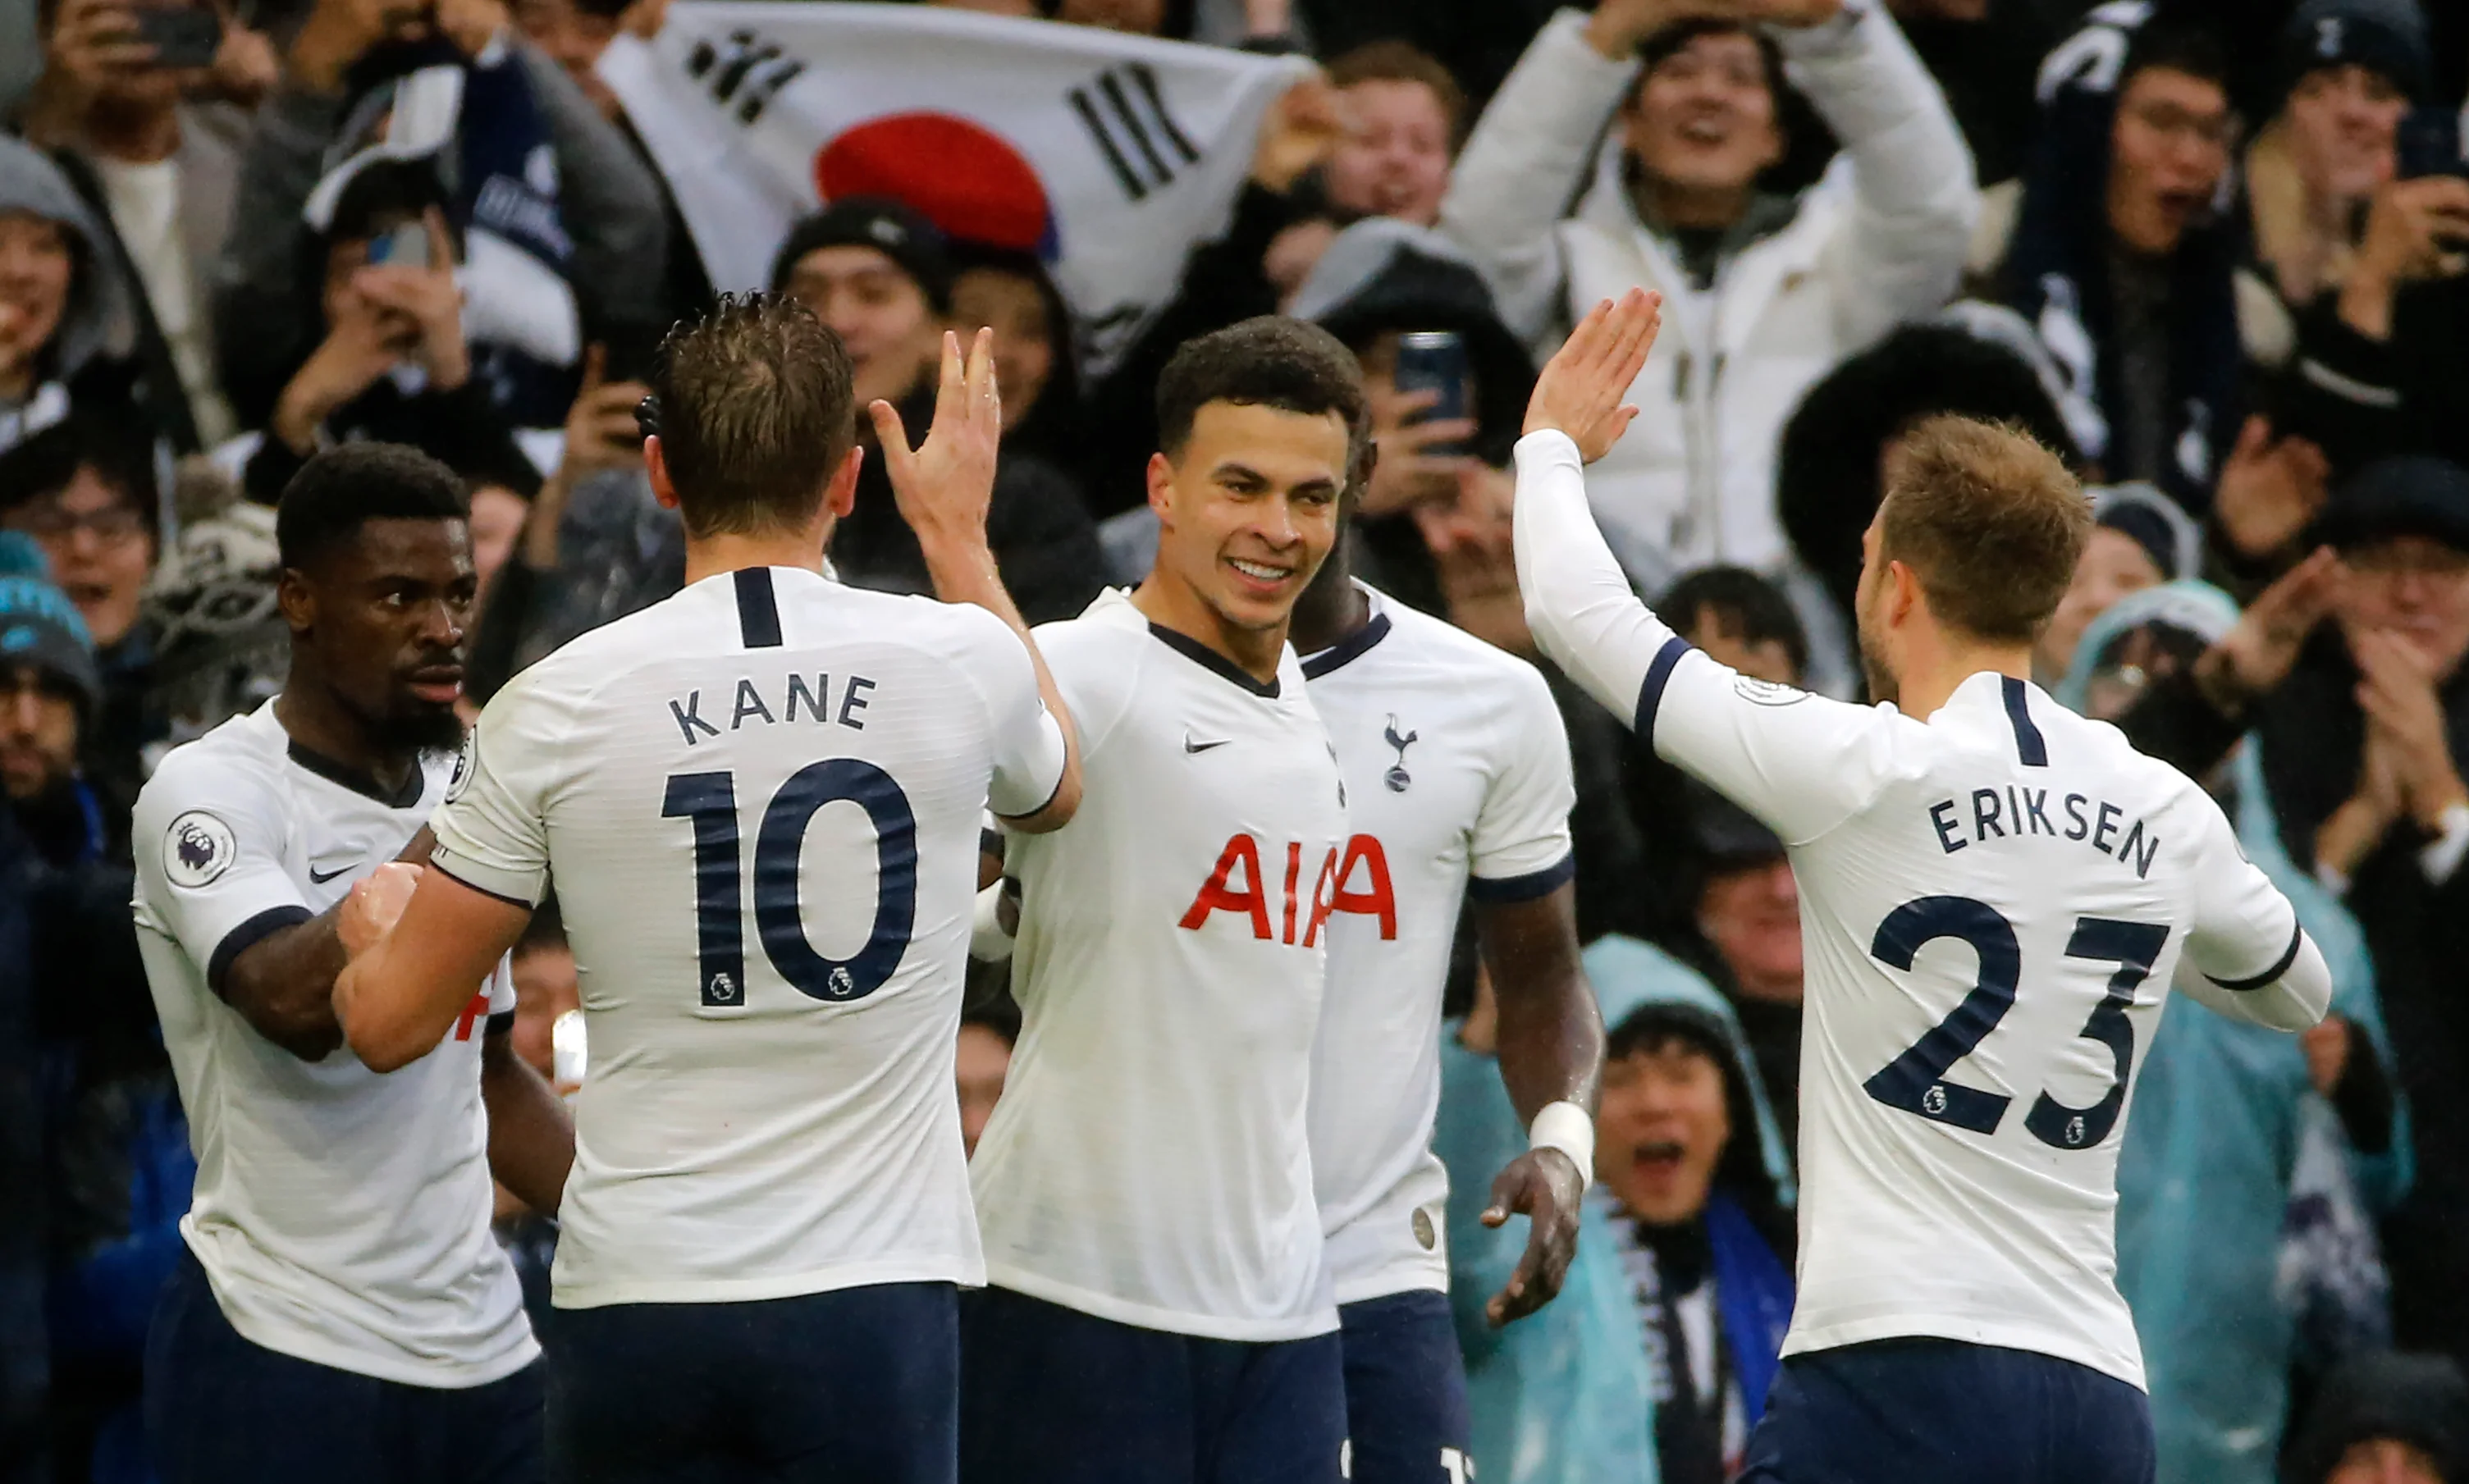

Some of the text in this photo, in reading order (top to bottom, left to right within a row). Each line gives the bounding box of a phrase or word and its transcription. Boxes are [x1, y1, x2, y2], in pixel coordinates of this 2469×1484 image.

[669, 673, 876, 747] KANE
[661, 757, 918, 1007] 10
[1929, 784, 2160, 879] ERIKSEN
[1862, 894, 2171, 1150] 23
